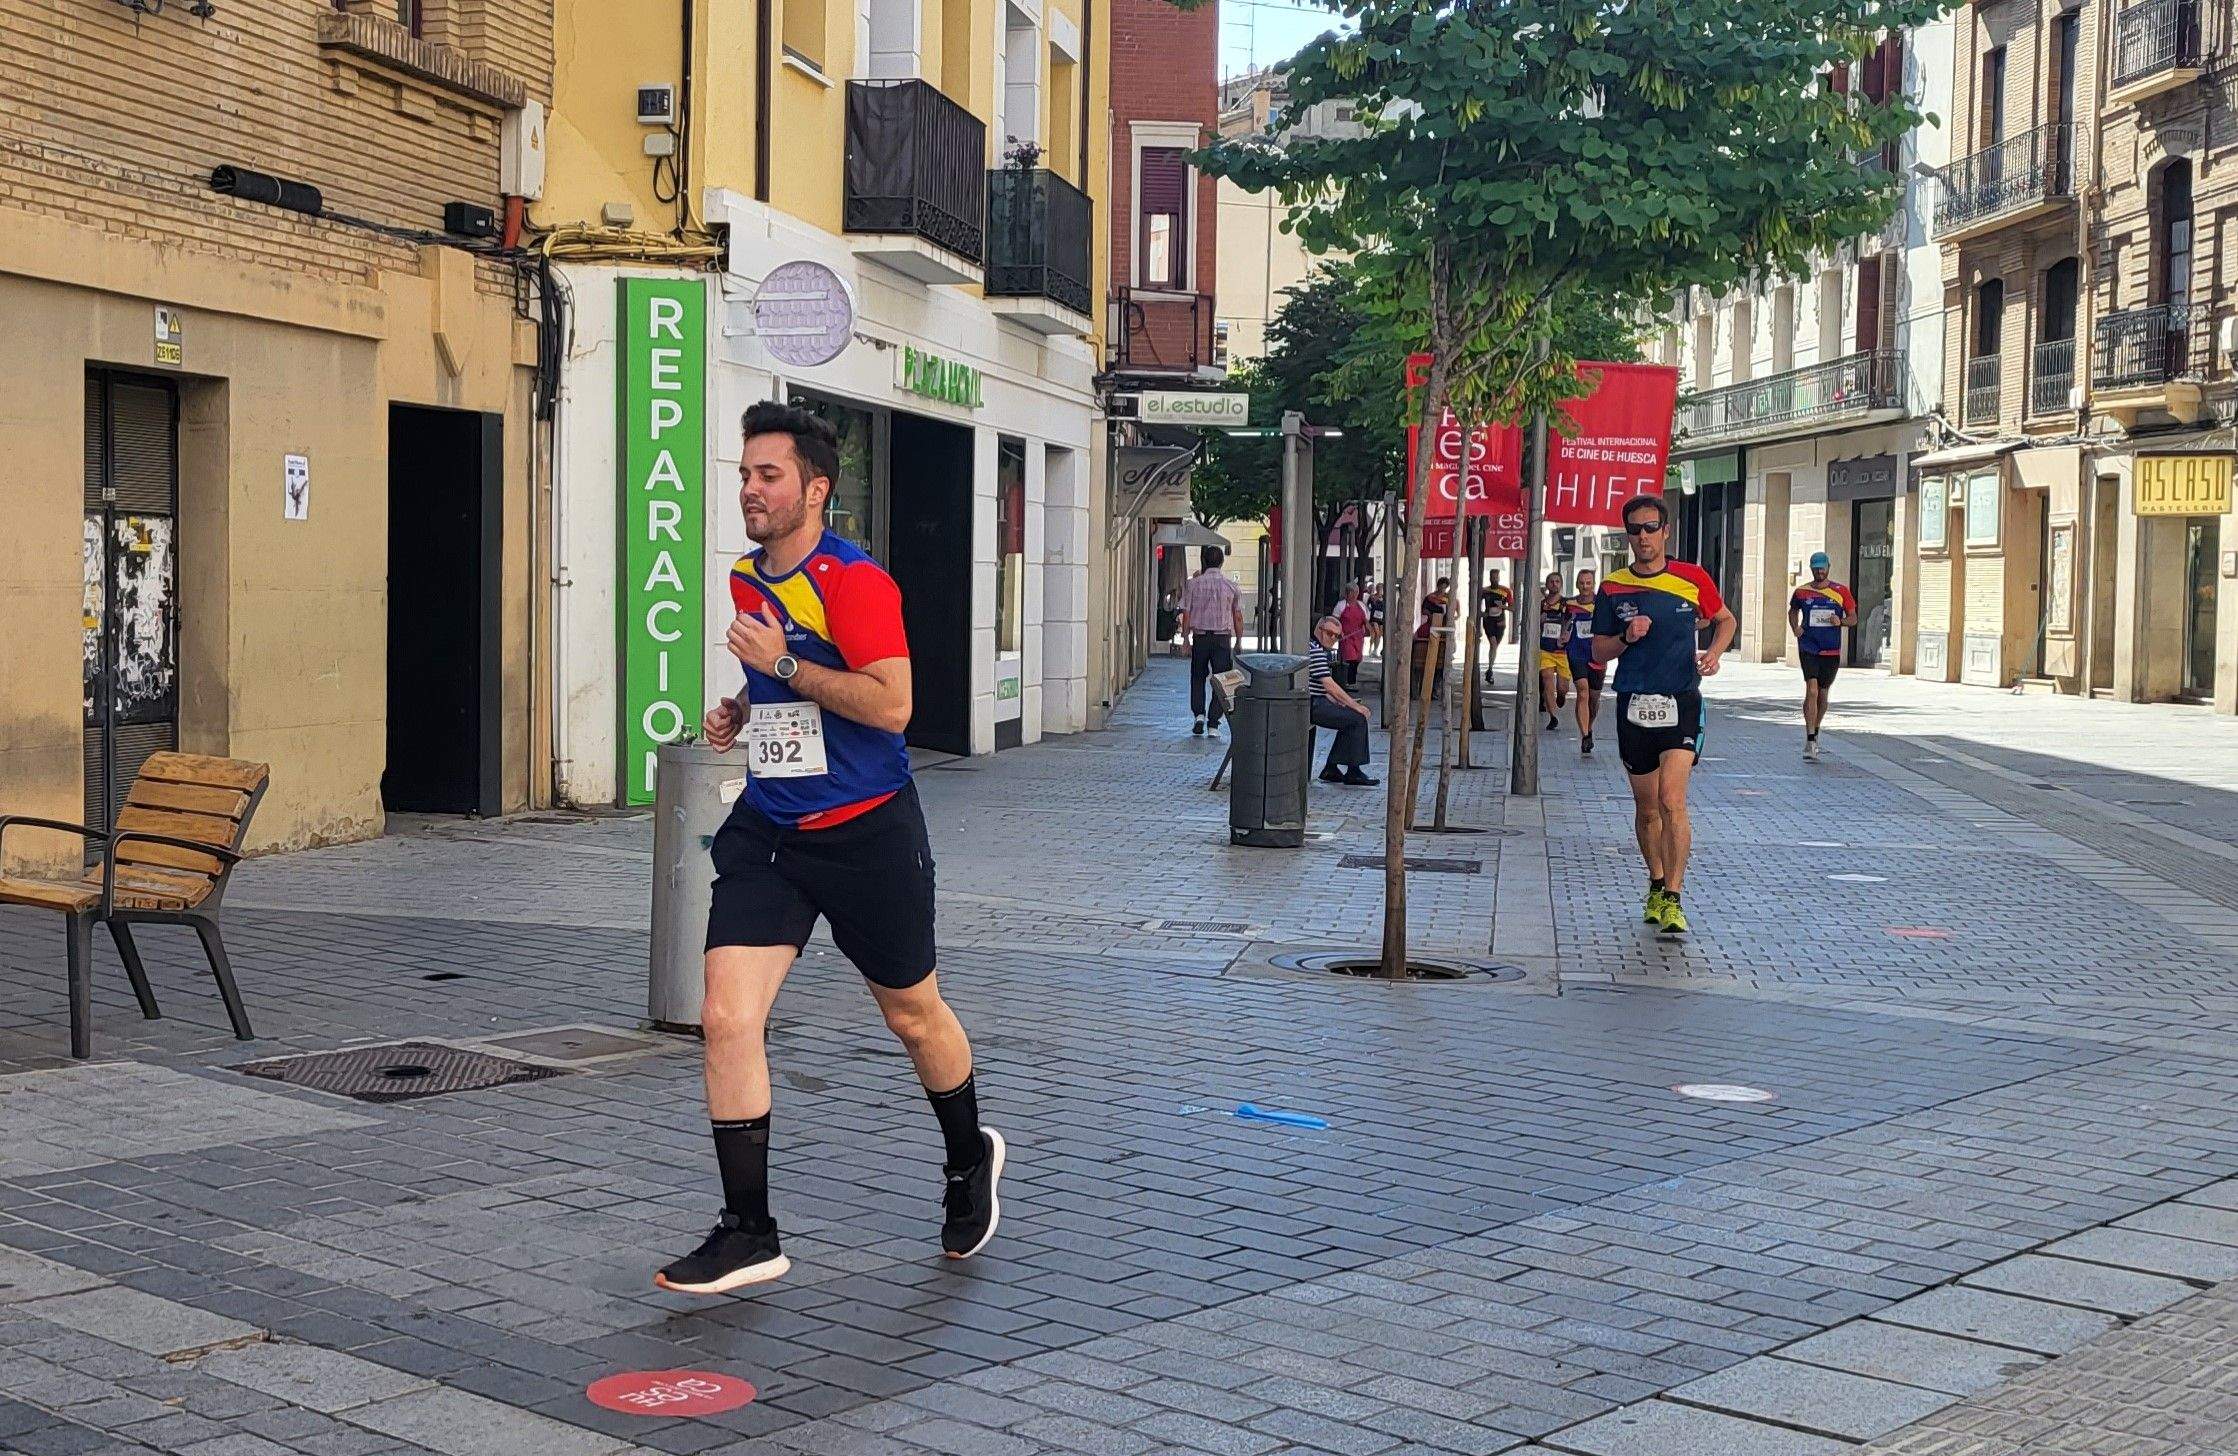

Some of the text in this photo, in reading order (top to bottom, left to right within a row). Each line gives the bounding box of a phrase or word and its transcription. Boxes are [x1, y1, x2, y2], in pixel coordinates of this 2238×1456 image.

[1147, 395, 1244, 415] el.estudio
[1440, 430, 1486, 460] es
[1561, 447, 1657, 465] DE CINE DE HUESCA
[1440, 473, 1488, 500] ca
[2142, 459, 2226, 501] ASCASO
[1499, 513, 1524, 529] es
[1498, 535, 1524, 550] ca
[1638, 710, 1667, 721] 689
[758, 740, 803, 764] 392
